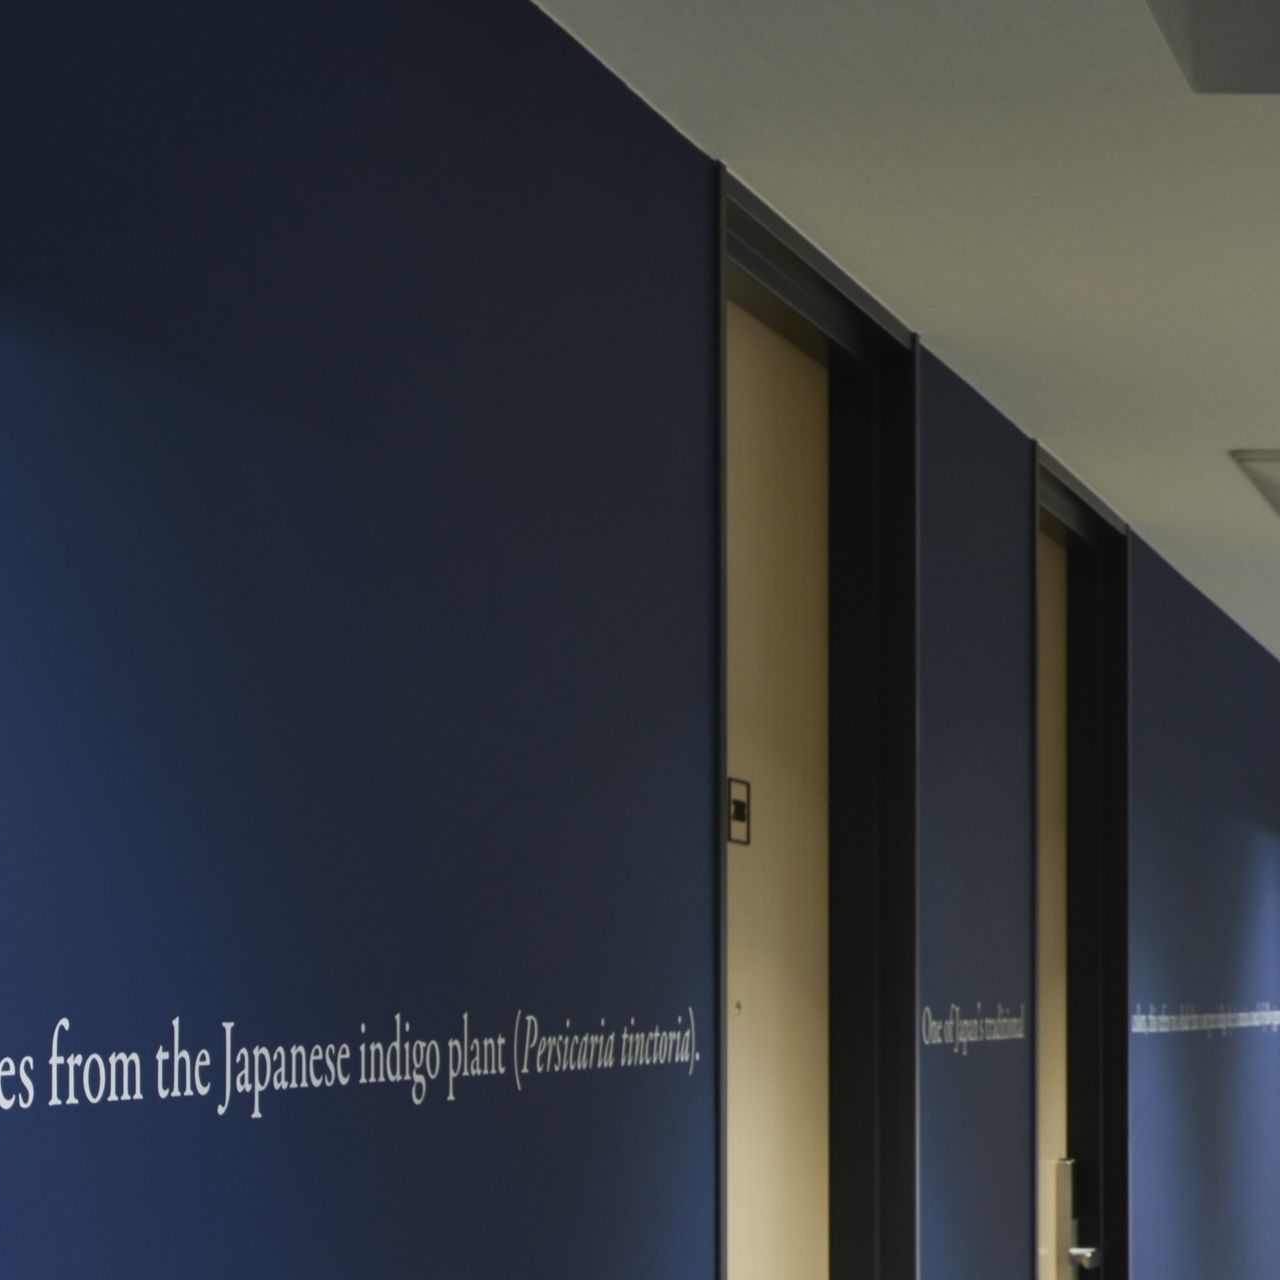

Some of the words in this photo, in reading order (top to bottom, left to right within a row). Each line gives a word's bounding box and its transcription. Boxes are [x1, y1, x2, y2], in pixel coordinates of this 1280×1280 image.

[922, 1006, 942, 1045] One
[943, 1003, 954, 1043] of
[48, 1017, 144, 1106] from
[156, 1015, 210, 1099] the
[217, 1021, 351, 1119] Japanese
[358, 1012, 441, 1106] indigo
[447, 1011, 506, 1101] plant
[513, 1009, 615, 1091] (Persicaria
[620, 1007, 700, 1075] tinctoria).
